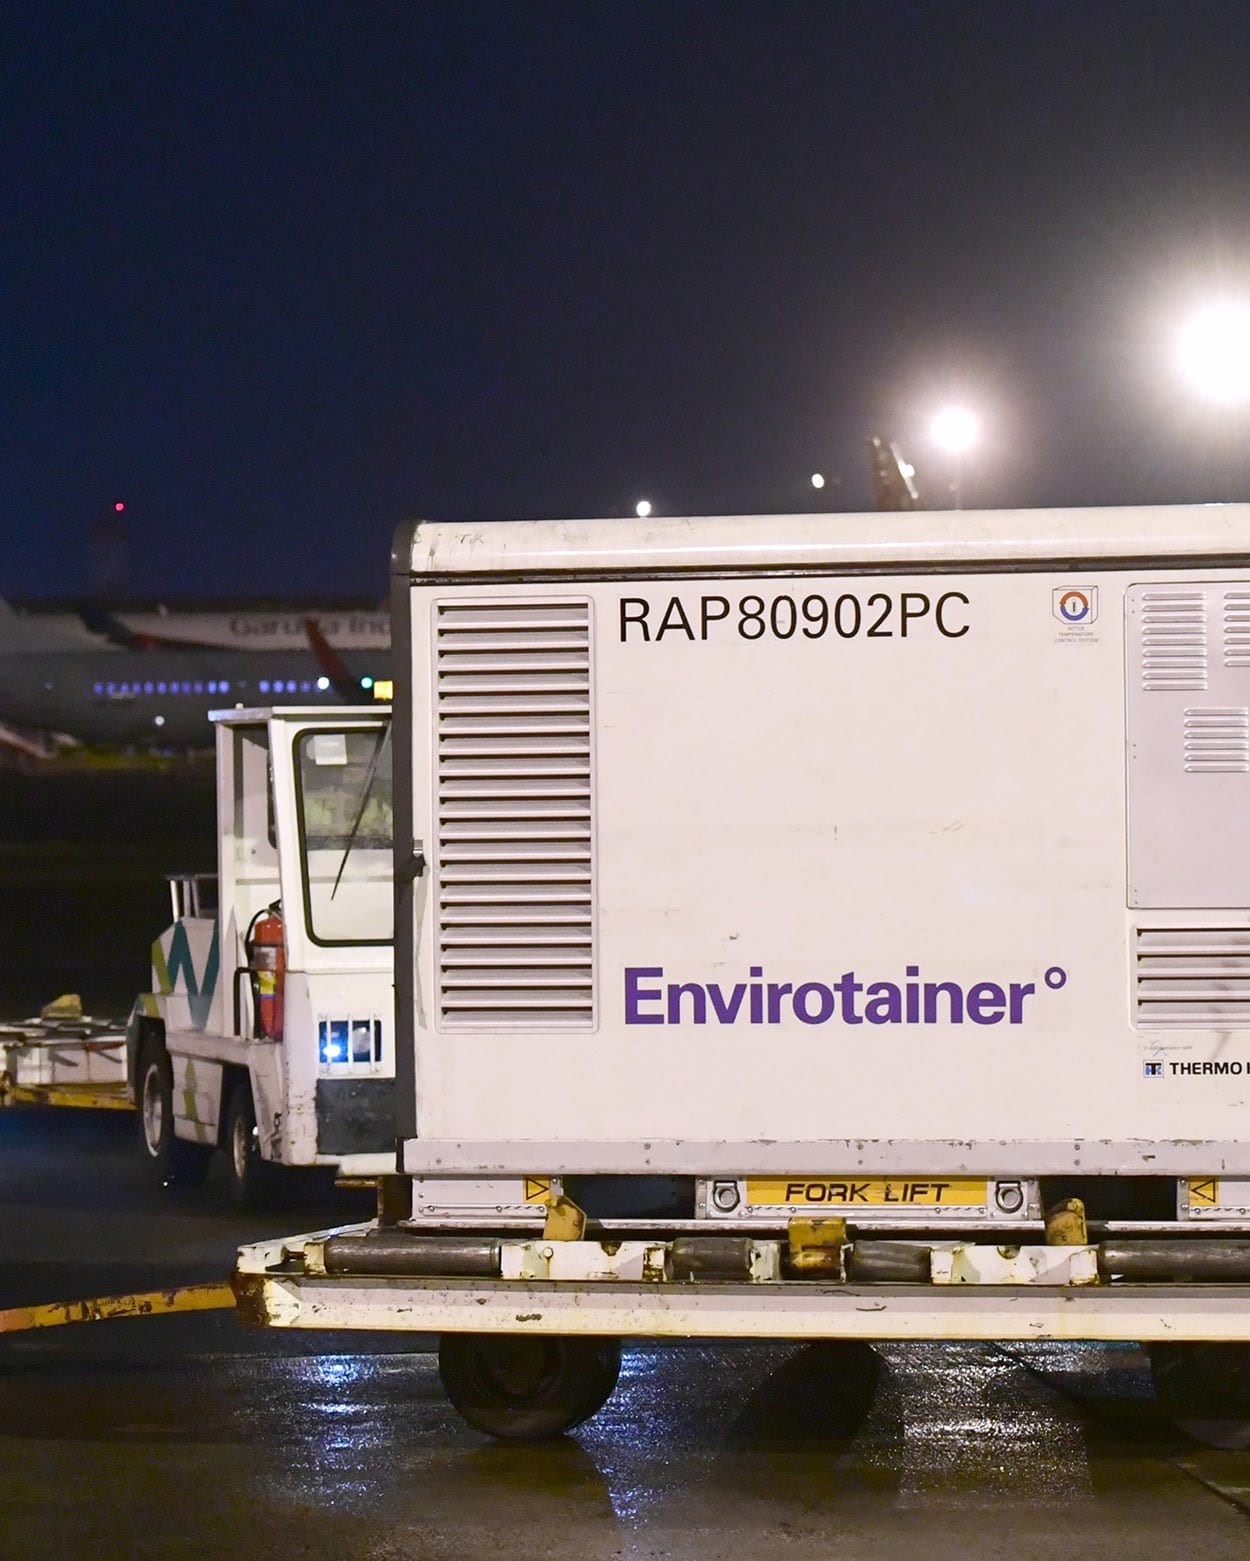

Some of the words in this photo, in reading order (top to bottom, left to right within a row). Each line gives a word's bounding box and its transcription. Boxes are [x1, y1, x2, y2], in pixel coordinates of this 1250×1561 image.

[230, 616, 340, 636] Garua
[619, 591, 971, 642] RAP80902PC
[1169, 1061, 1243, 1075] THERMO
[785, 1183, 871, 1202] FORK
[884, 1183, 950, 1202] LIFT
